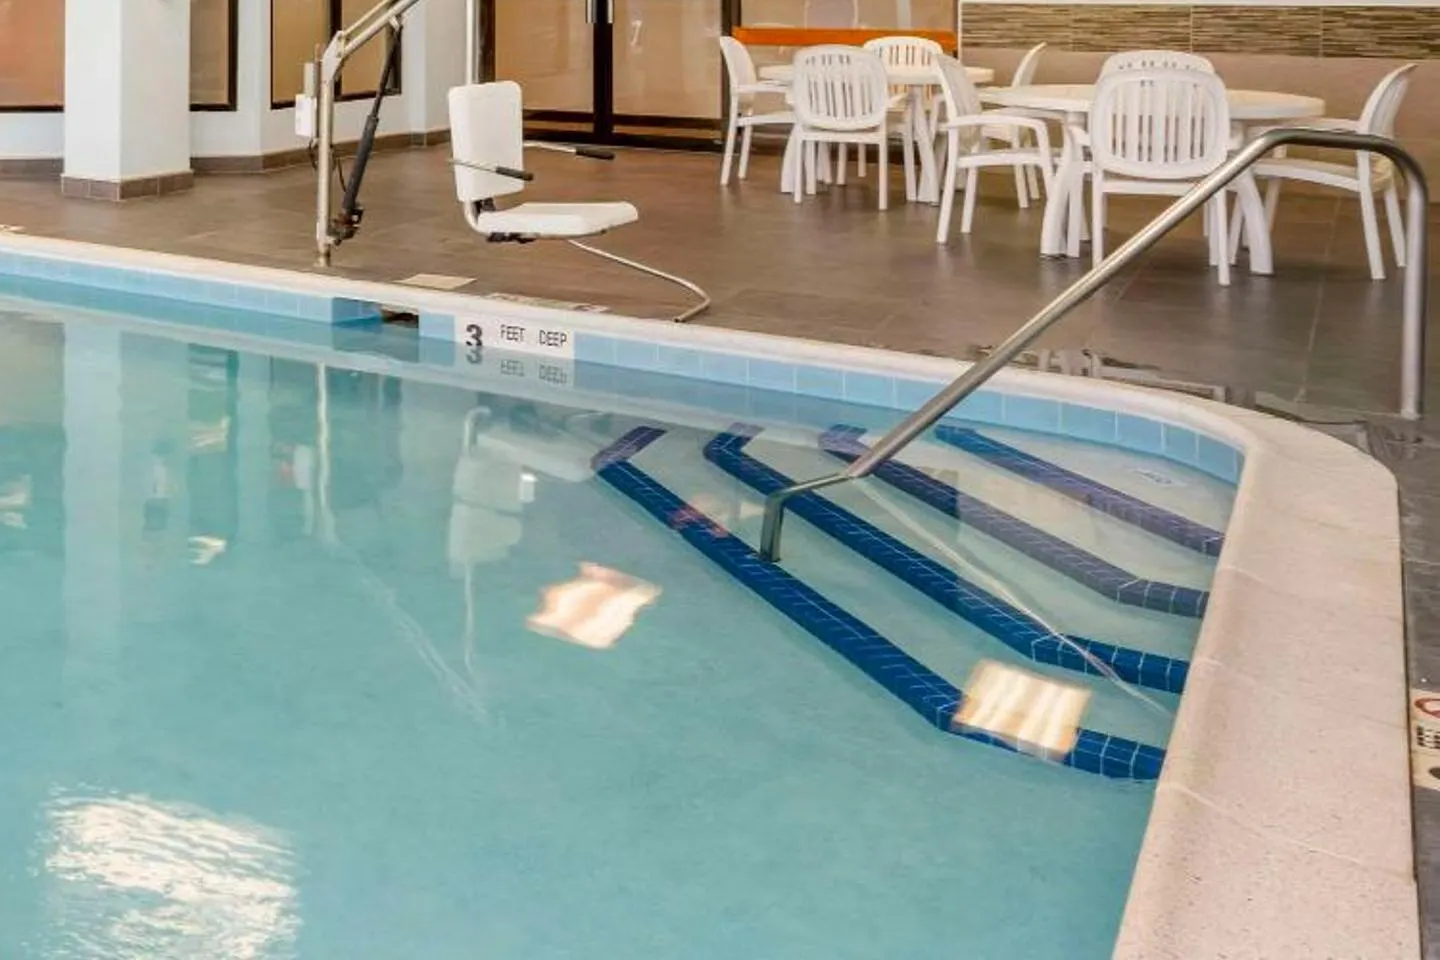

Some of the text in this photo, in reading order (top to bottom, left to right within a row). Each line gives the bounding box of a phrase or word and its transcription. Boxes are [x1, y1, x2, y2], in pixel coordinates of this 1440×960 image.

[466, 324, 567, 347] 3 FEET DEEP
